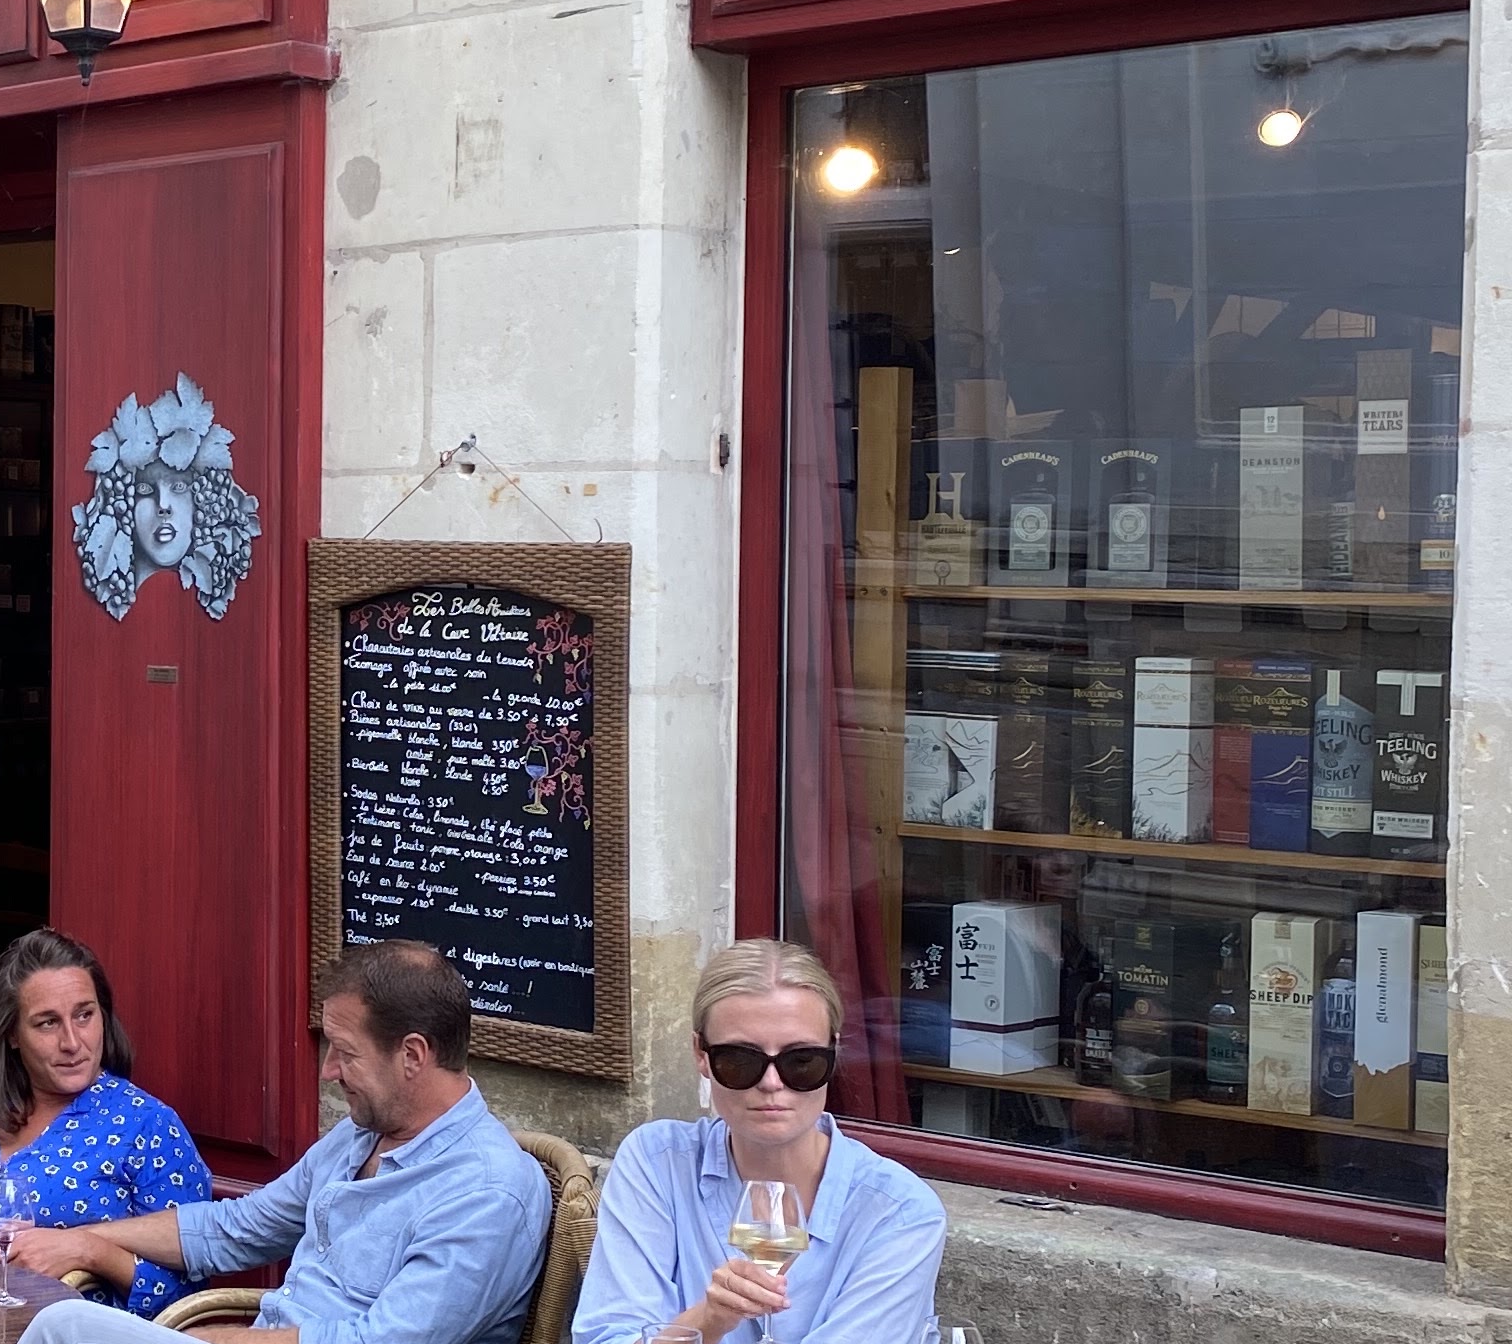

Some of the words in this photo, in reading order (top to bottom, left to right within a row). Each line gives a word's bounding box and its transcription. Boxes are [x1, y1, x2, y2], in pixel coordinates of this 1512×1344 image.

[1363, 419, 1403, 432] TEARS
[1242, 457, 1301, 467] DEANSTON
[397, 617, 415, 634] de
[419, 620, 431, 637] la
[442, 623, 471, 640] Cave
[476, 650, 492, 664] du
[386, 700, 399, 712] de
[1315, 718, 1372, 745] EELING
[1376, 738, 1437, 759] TEELING
[1381, 769, 1428, 784] WHISKEY
[955, 922, 981, 981] 富士
[1118, 970, 1169, 986] TOMATIN
[1249, 989, 1290, 1003] SHEEP
[1292, 991, 1314, 1005] DIP
